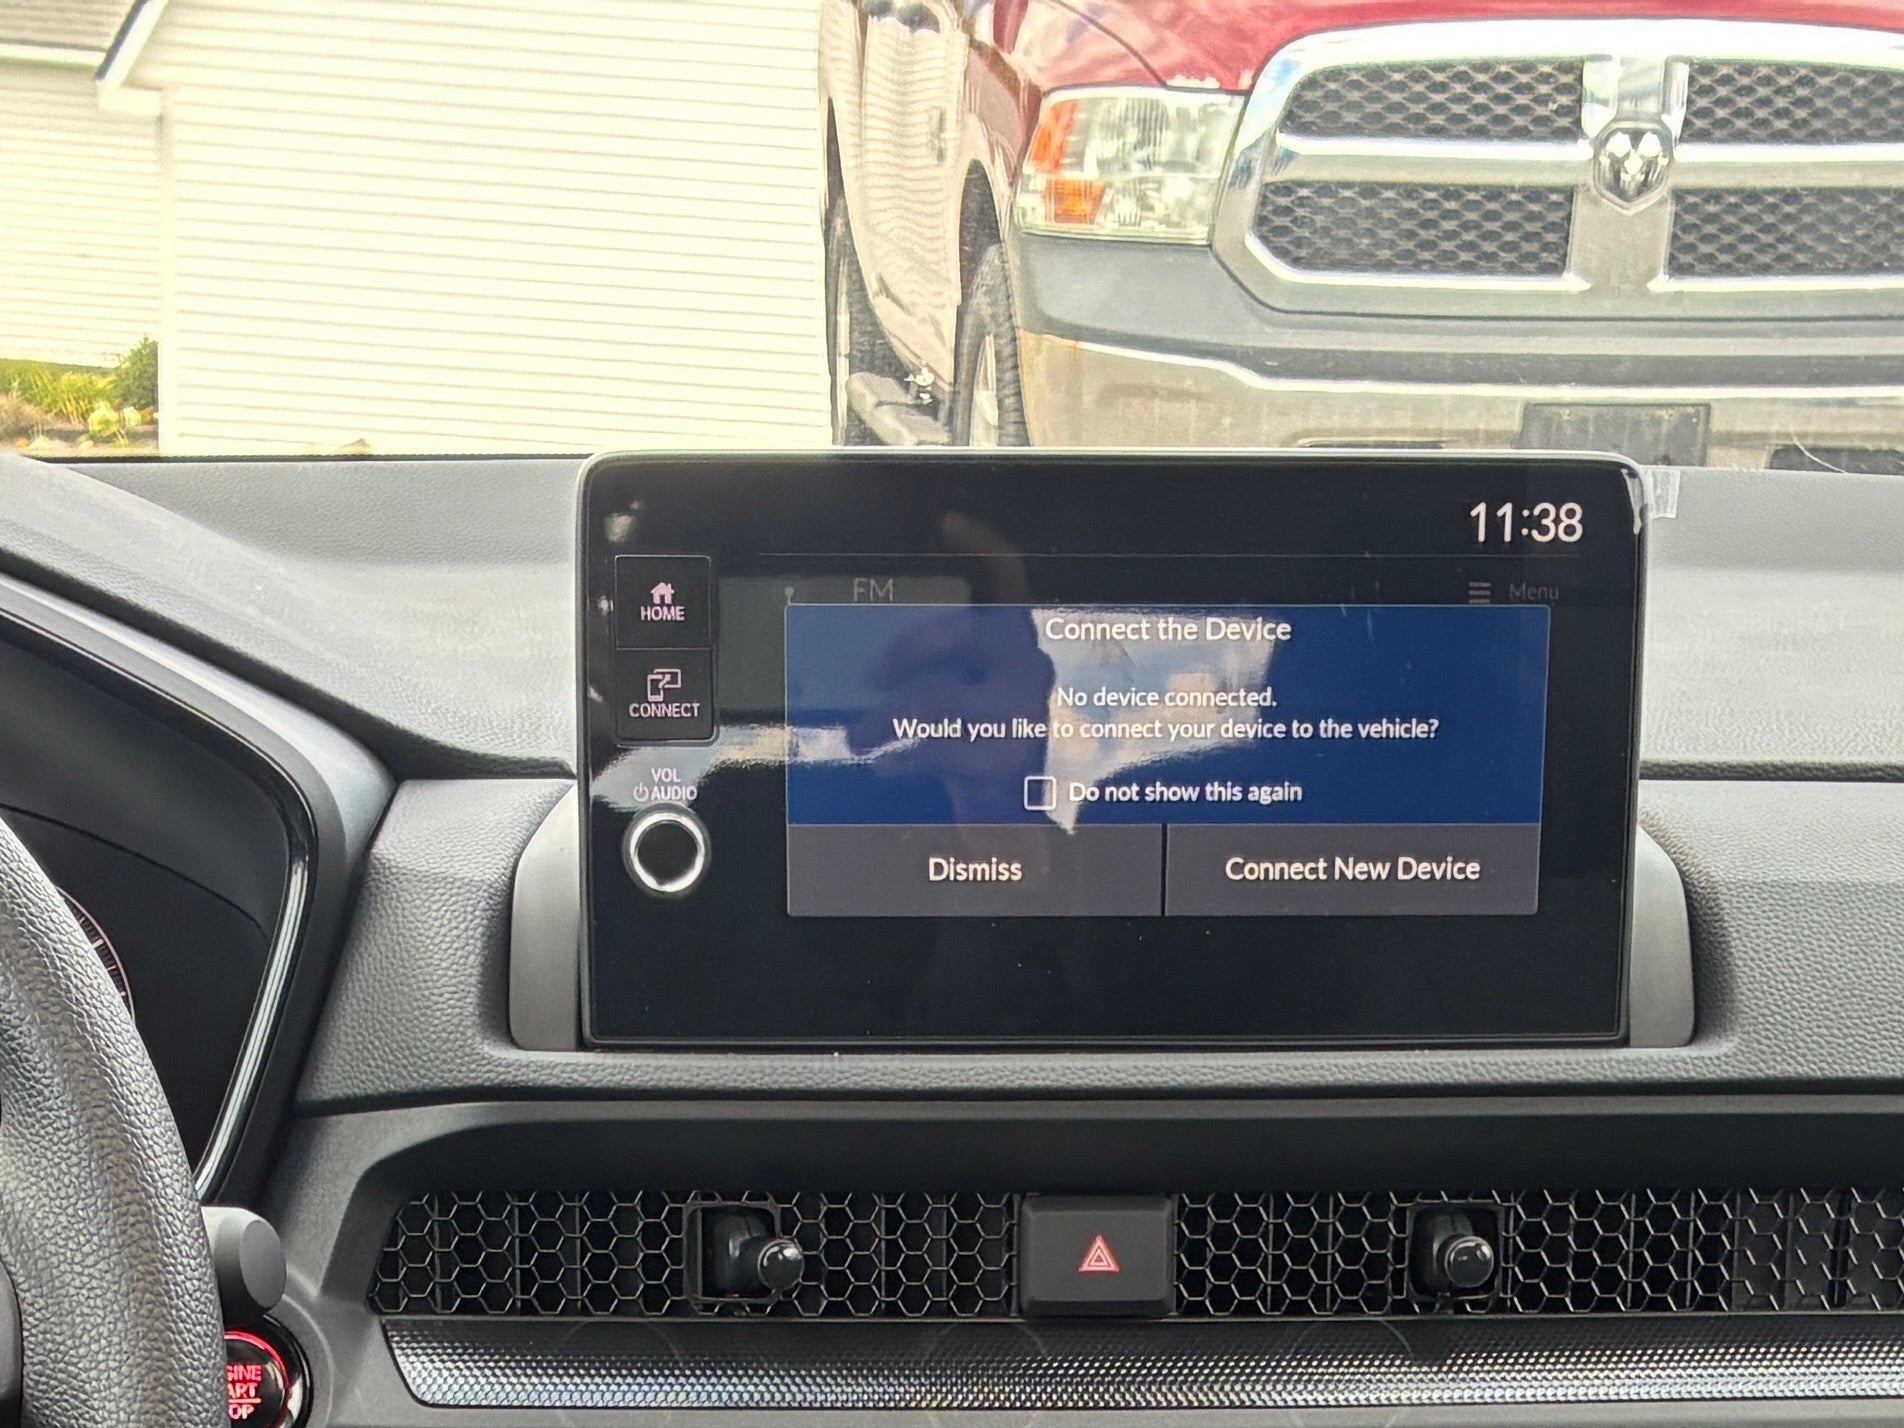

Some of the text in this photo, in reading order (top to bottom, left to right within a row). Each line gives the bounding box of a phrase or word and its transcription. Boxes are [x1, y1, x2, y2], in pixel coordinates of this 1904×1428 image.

[1469, 501, 1584, 543] 11:38
[852, 577, 895, 602] FM
[1507, 582, 1561, 601] Menu
[639, 605, 686, 622] HOME
[1045, 616, 1293, 641] Connect the Device
[1055, 686, 1278, 708] No device connected.
[628, 702, 701, 719] CONNECT
[892, 717, 1440, 743] Would you like to connect your device to the vehicle?
[650, 767, 682, 783] VOL
[650, 784, 698, 802] AUDIO
[1068, 780, 1304, 806] Do not show this again
[927, 856, 1024, 882] Dismiss
[1224, 854, 1482, 881] Connect New Device
